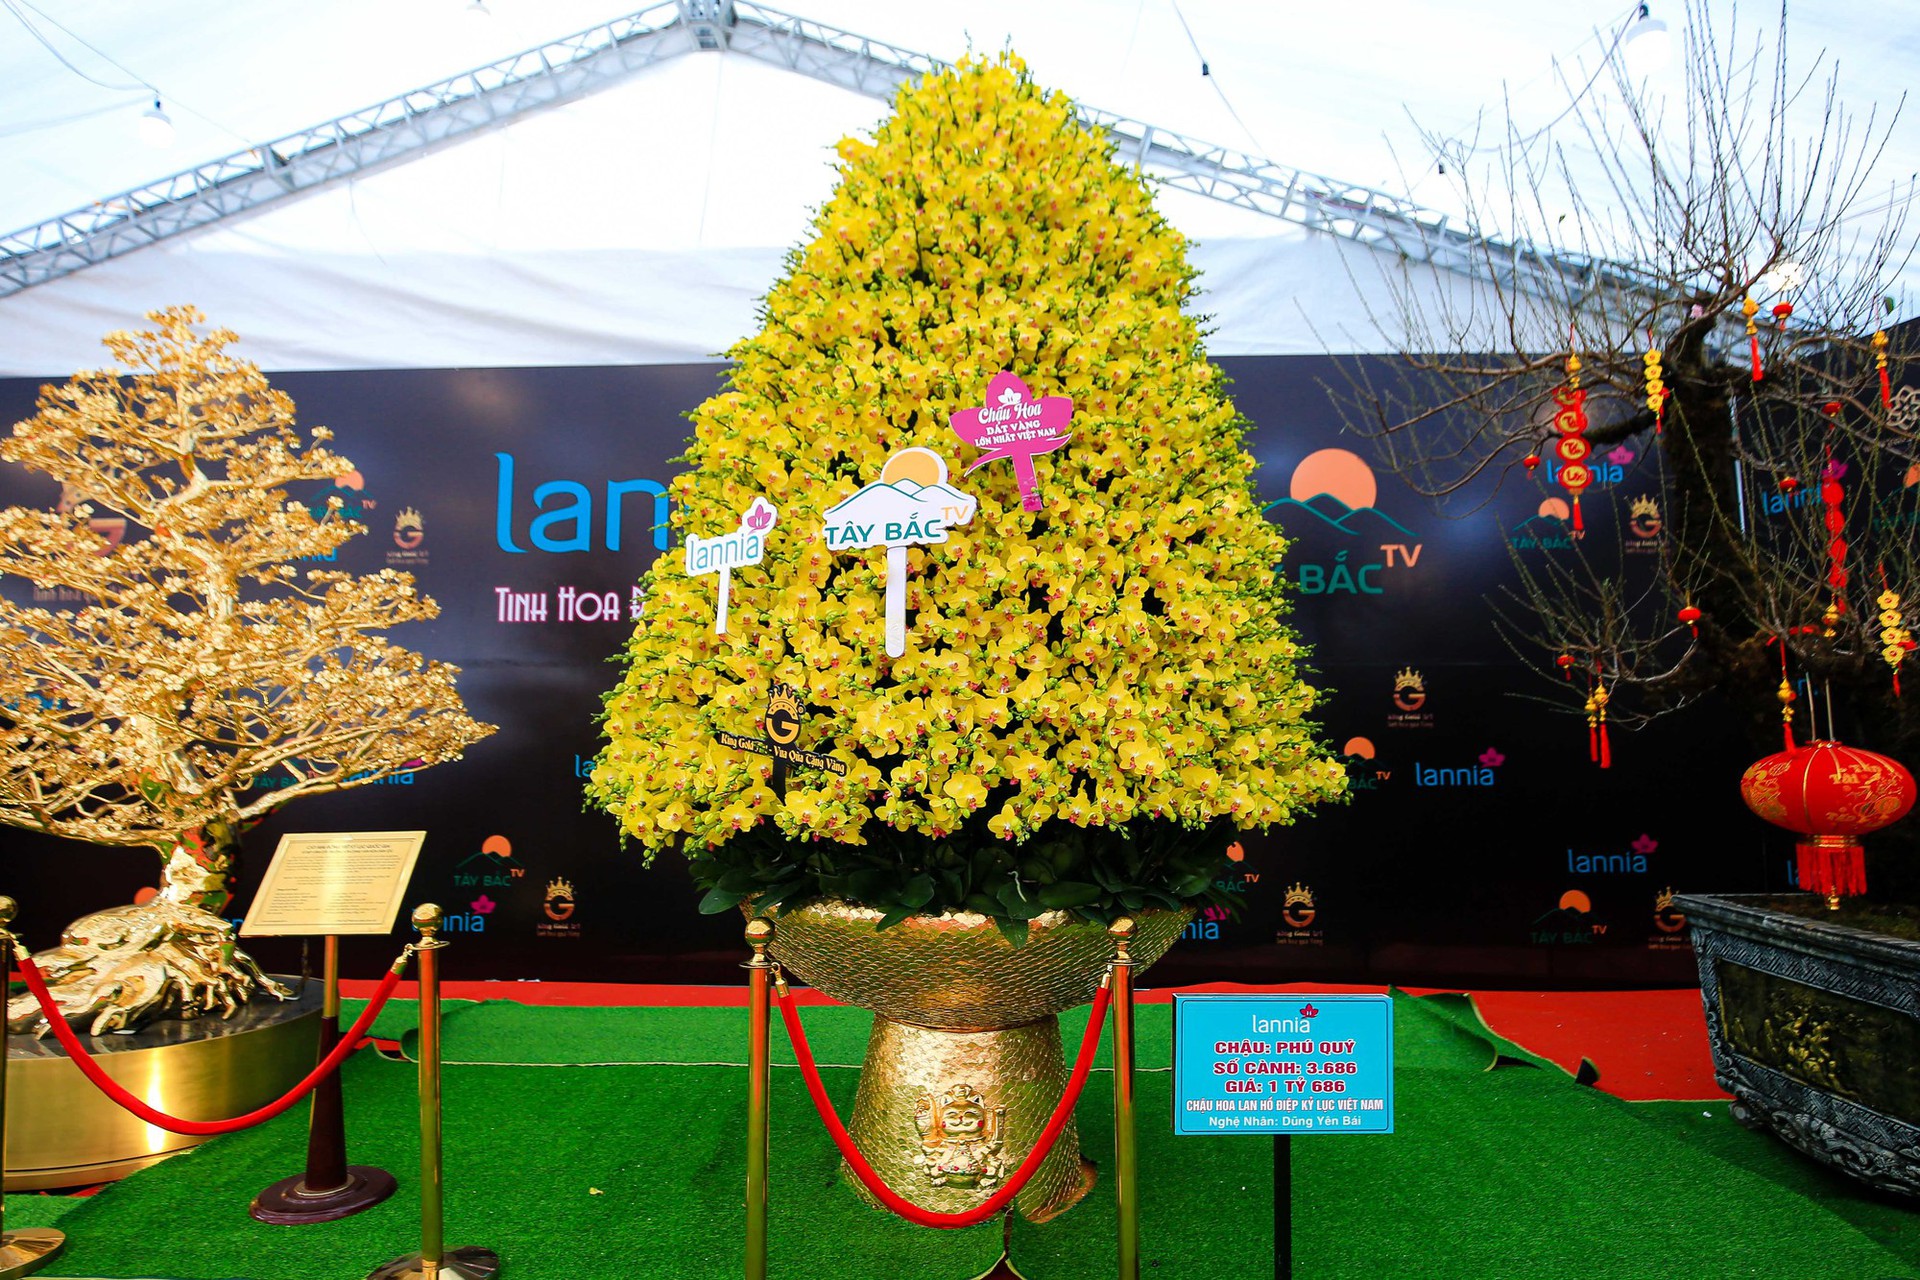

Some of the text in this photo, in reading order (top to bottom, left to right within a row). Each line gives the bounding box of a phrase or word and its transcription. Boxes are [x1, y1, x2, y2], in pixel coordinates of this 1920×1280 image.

[1014, 402, 1042, 420] Hoa
[1010, 420, 1041, 432] VÀNG
[1017, 429, 1037, 441] VIỆT
[1037, 427, 1057, 438] NAM
[941, 505, 969, 520] TV
[825, 511, 941, 544] TÂY BẮC
[691, 532, 759, 570] lannia
[1380, 544, 1423, 568] TV
[1299, 549, 1383, 595] BẮC
[558, 585, 621, 622] HOA
[721, 732, 738, 749] King
[738, 738, 755, 752] Gold
[774, 746, 787, 759] Vua
[825, 757, 846, 776] Vàng
[1376, 771, 1391, 780] TV
[1415, 762, 1494, 787] lannia
[1567, 848, 1647, 874] lannia
[510, 868, 525, 878] TV
[1244, 873, 1260, 883] TV
[1592, 924, 1607, 934] TV
[1252, 1014, 1310, 1033] lannia
[1214, 1038, 1355, 1057] CHẬU: PHÚ QUÝ
[1214, 1058, 1357, 1075] SỐ CÀNH: 3.686
[1225, 1077, 1345, 1093] GIÁ: 1 TỶ 686
[1186, 1098, 1213, 1114] CHẬU
[1216, 1099, 1236, 1111] HOA
[1238, 1099, 1258, 1111] LAN
[1316, 1099, 1335, 1113] LỤC
[1337, 1097, 1359, 1113] VIỆT
[1360, 1099, 1384, 1111] NAM
[1209, 1115, 1362, 1128] Nghệ Nhân: Dũng Yên Bái
